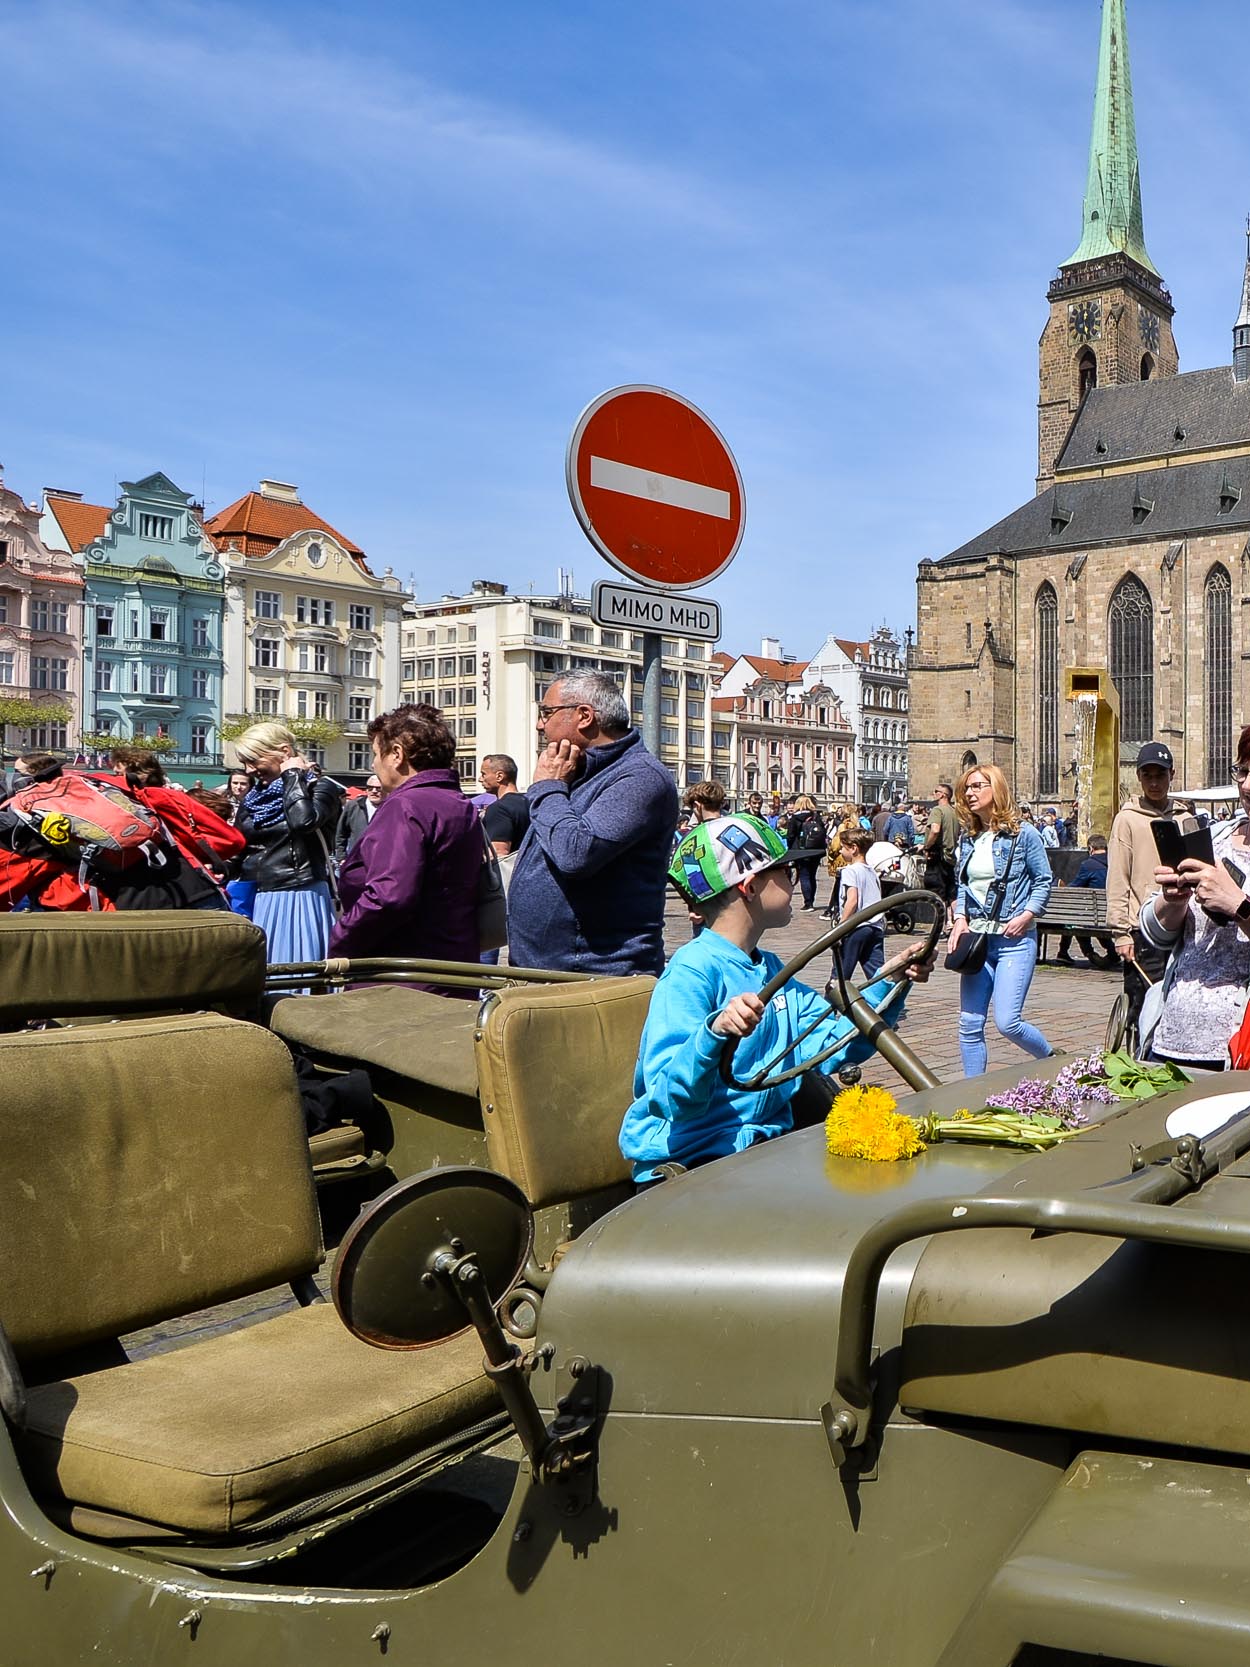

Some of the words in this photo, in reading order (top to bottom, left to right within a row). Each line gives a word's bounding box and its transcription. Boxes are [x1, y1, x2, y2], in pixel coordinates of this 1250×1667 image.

[611, 595, 664, 622] MIMO
[670, 607, 710, 630] MHD
[482, 651, 490, 696] HOTEL
